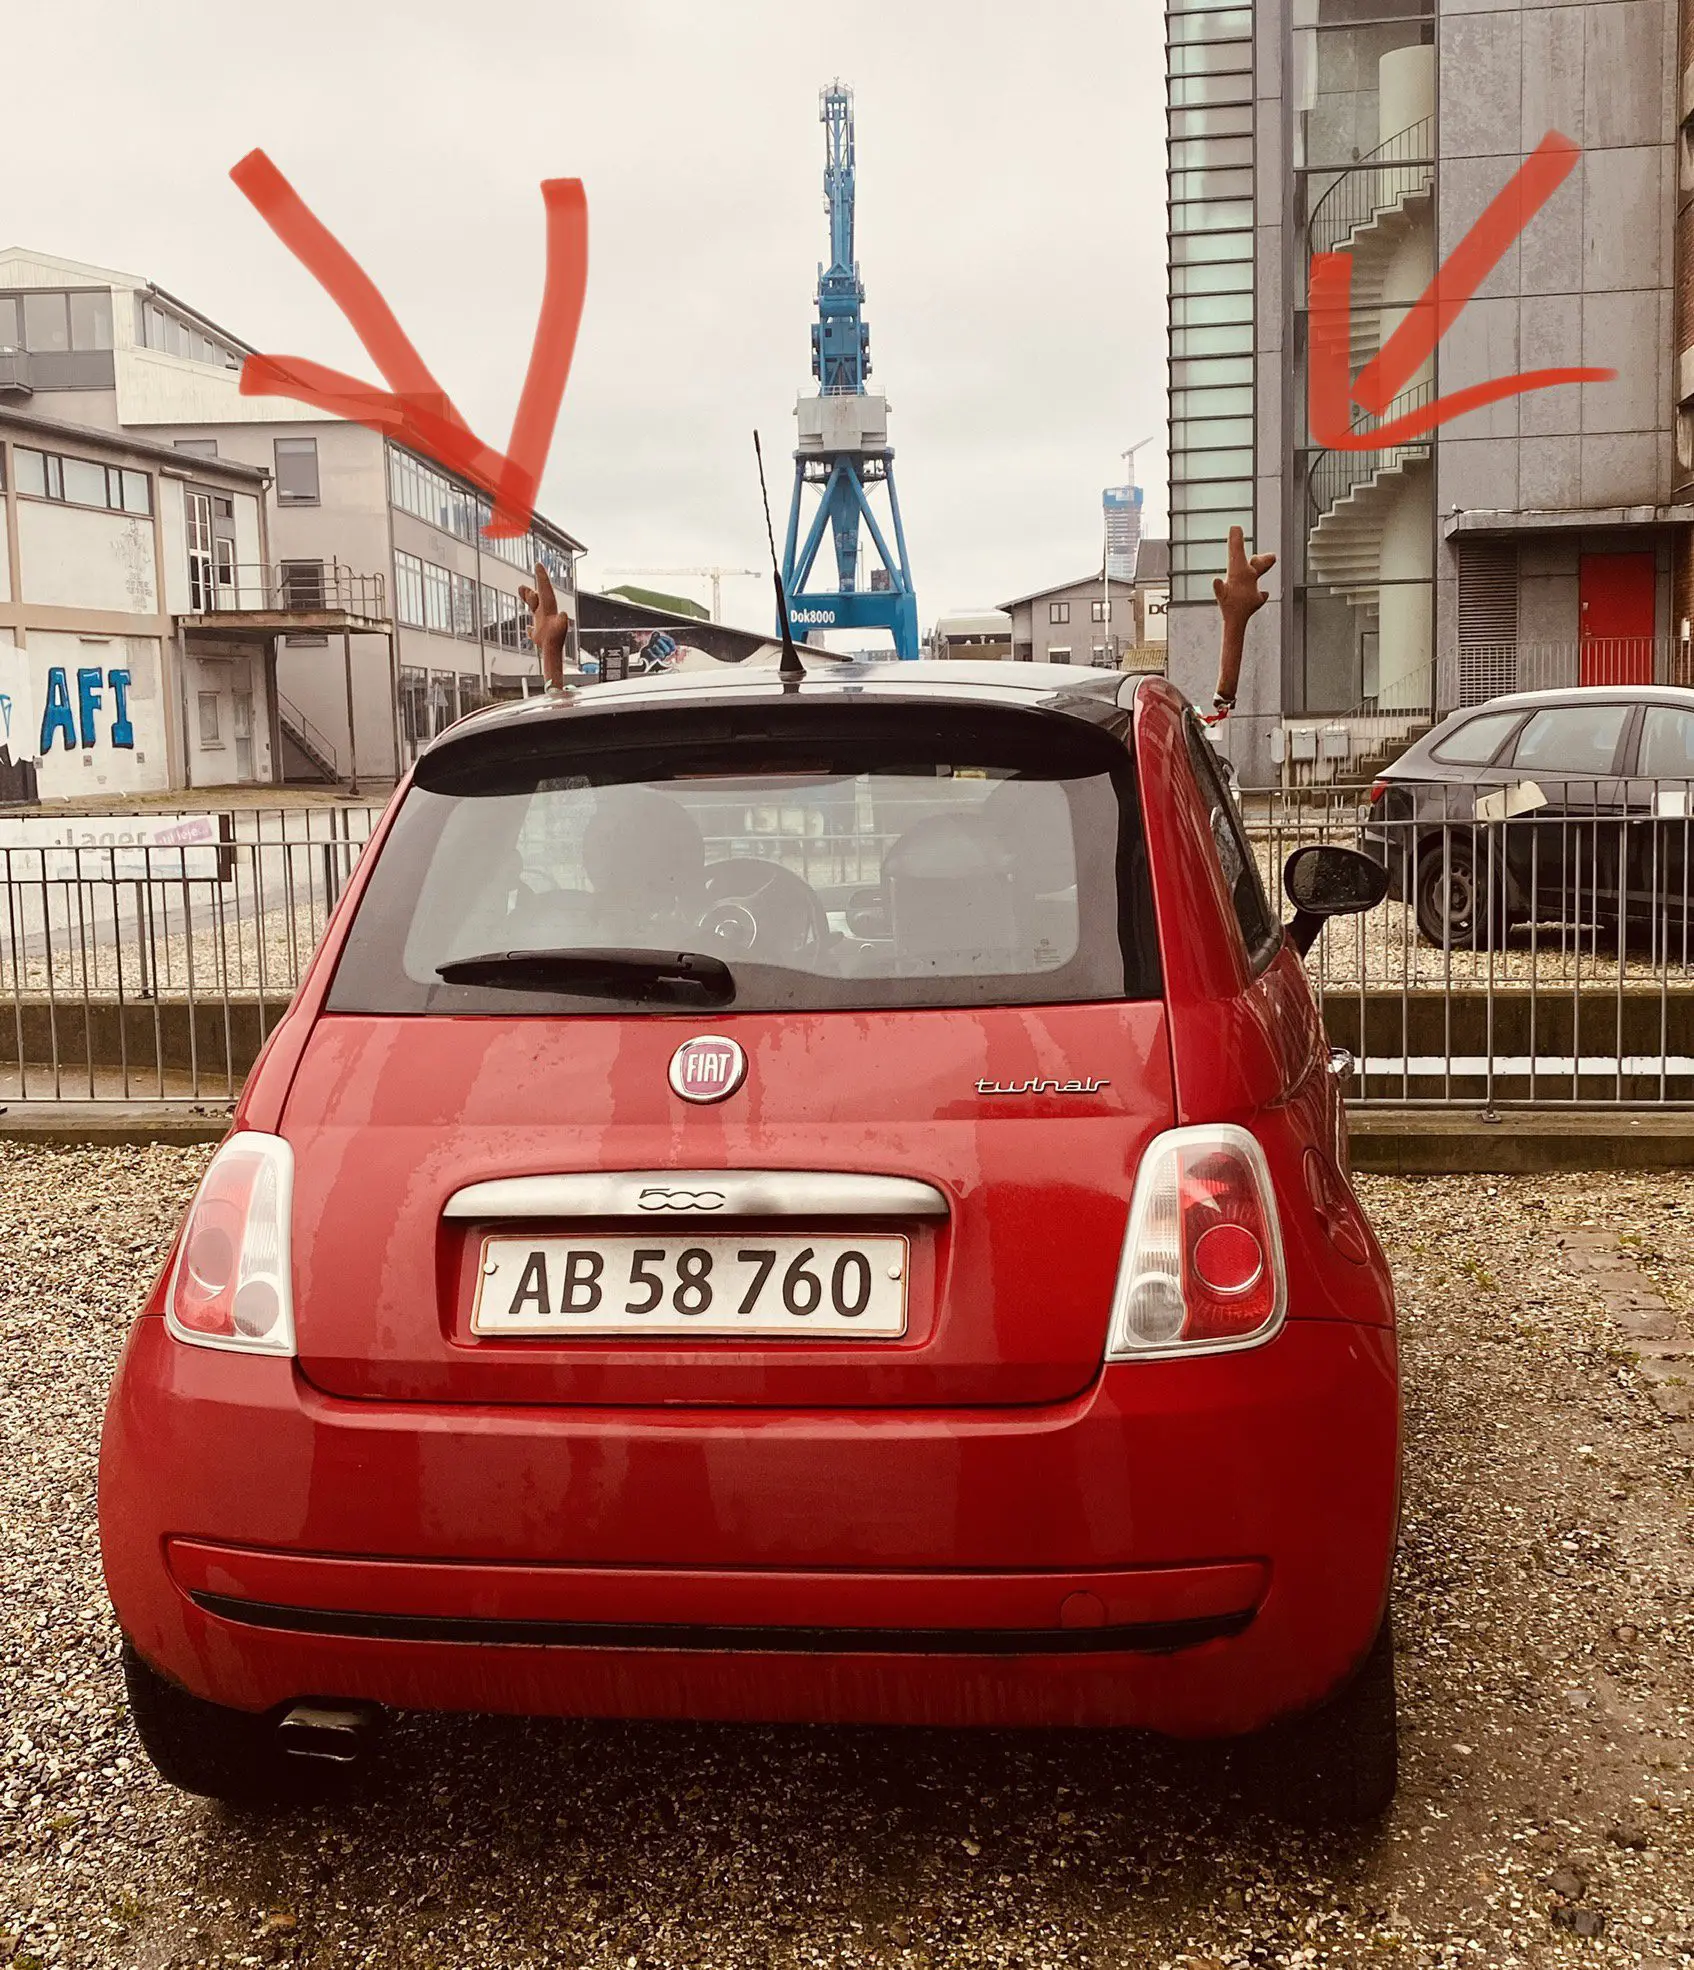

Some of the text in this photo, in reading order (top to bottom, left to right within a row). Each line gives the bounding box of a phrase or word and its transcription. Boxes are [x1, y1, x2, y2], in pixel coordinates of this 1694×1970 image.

[790, 608, 835, 624] Dok8000
[40, 667, 134, 756] AFI
[66, 828, 147, 861] lager
[686, 1052, 731, 1083] FIAT
[974, 1076, 1111, 1094] twinair
[638, 1188, 725, 1210] 500
[508, 1247, 871, 1318] AB 58 760
